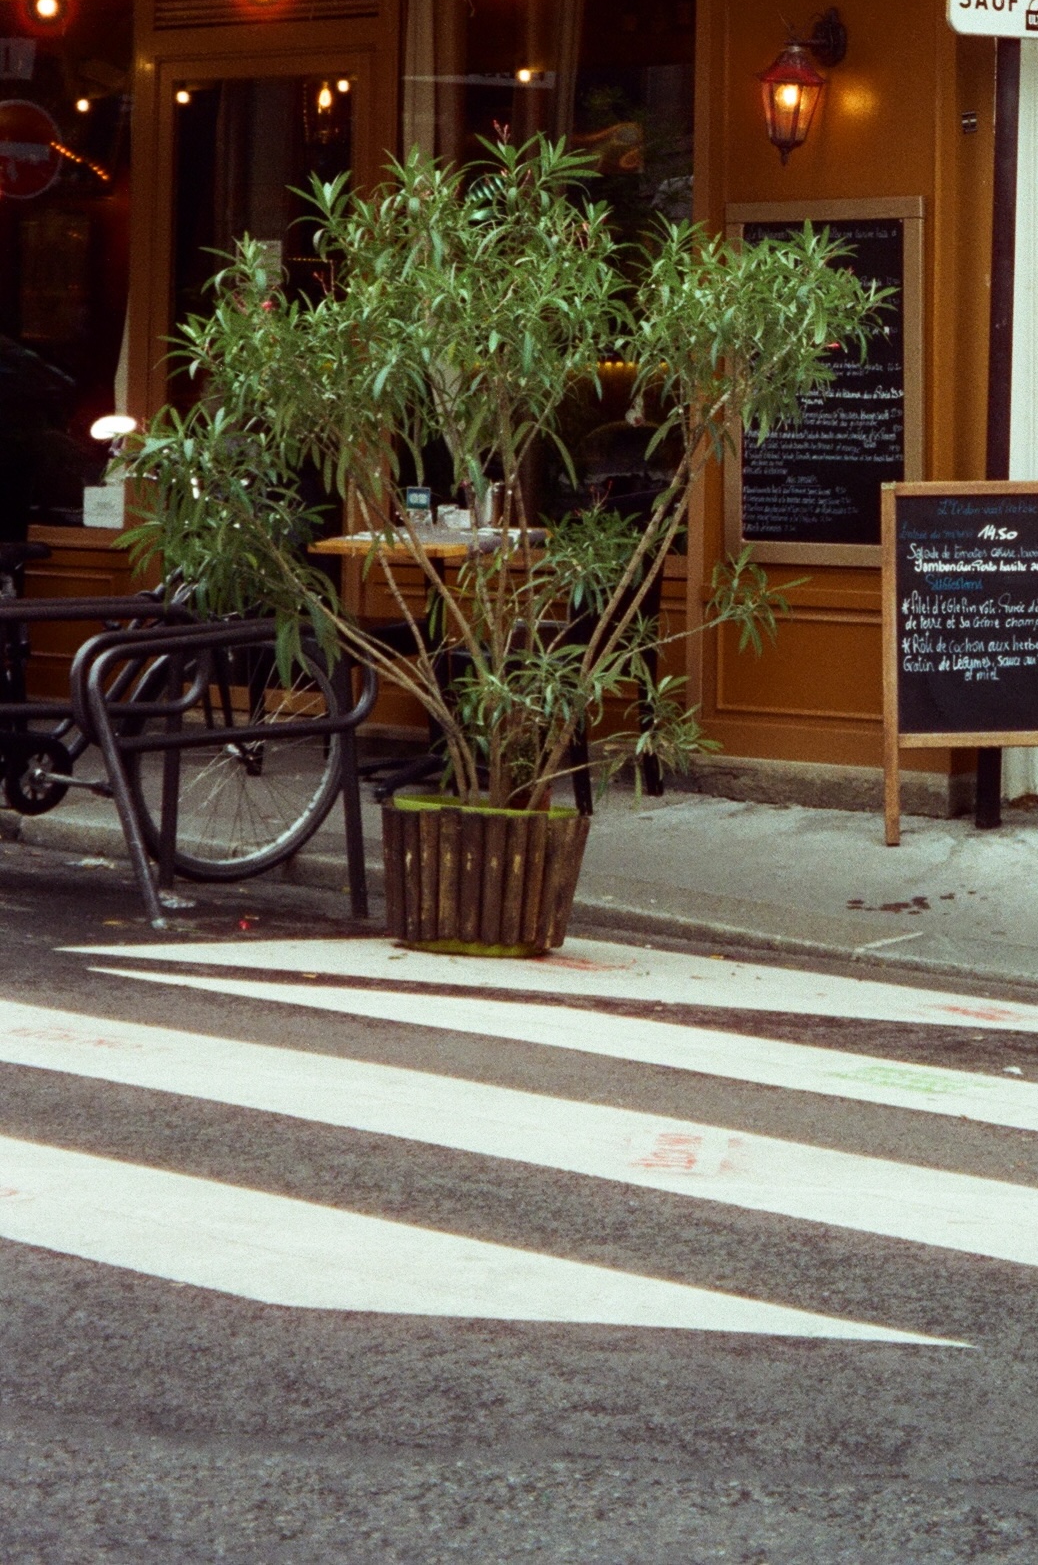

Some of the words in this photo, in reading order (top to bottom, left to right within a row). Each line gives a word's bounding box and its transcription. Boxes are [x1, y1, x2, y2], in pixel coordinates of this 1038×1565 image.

[977, 524, 1018, 541] 14.50
[905, 615, 917, 630] de
[988, 641, 1010, 652] aux
[903, 655, 935, 672] Gratin
